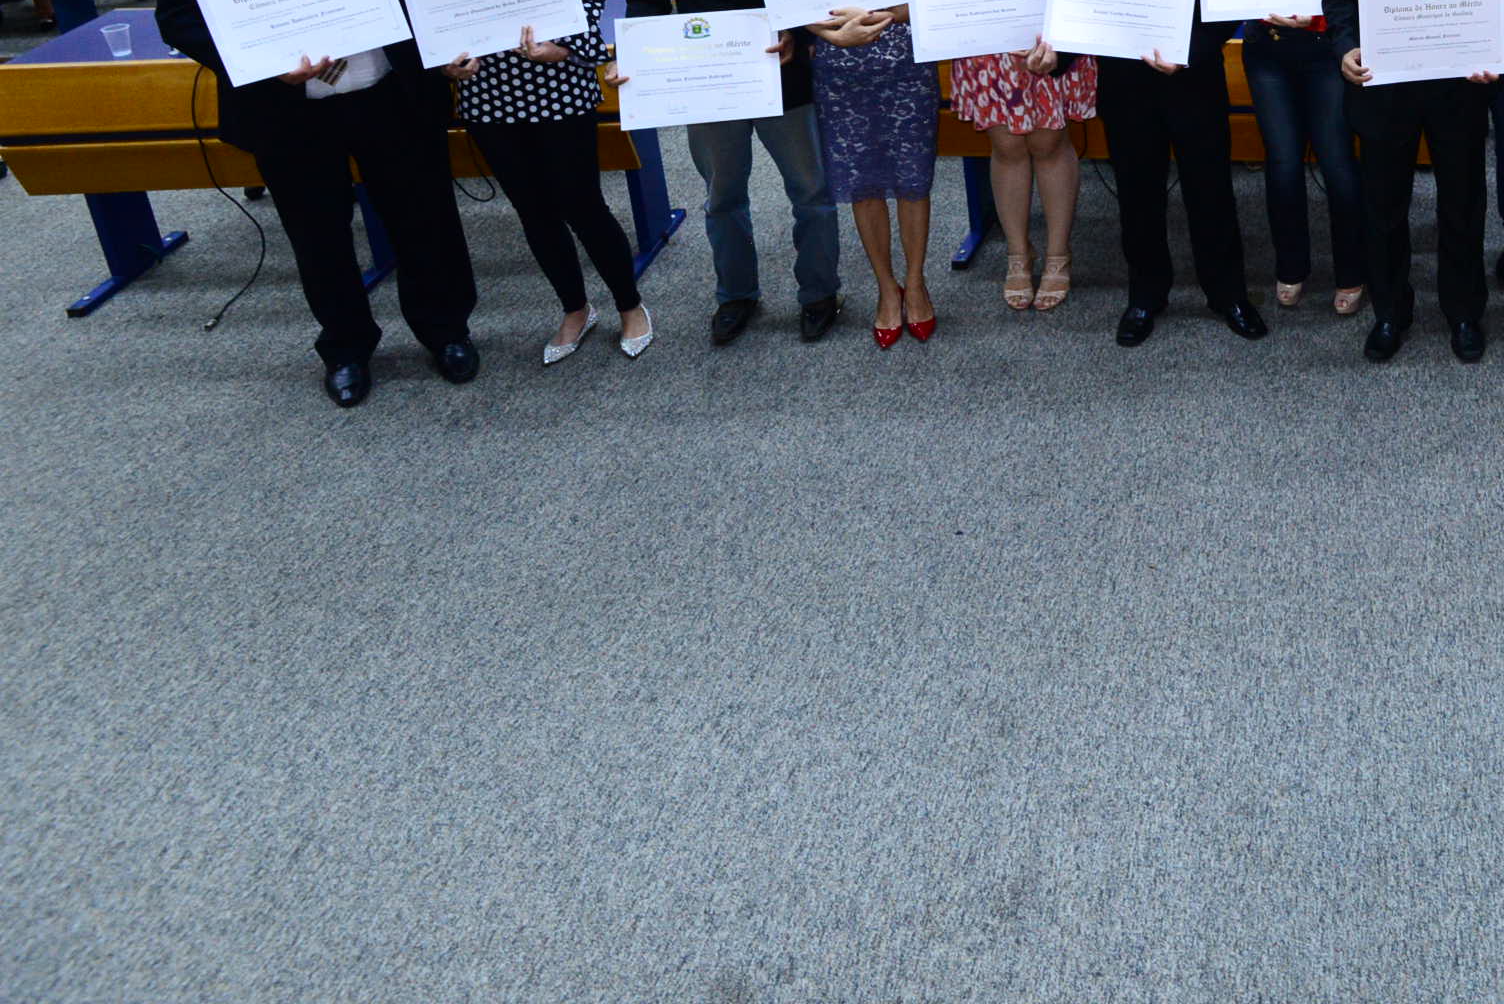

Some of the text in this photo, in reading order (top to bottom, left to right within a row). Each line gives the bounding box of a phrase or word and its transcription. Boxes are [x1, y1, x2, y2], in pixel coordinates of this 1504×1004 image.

[1383, 4, 1412, 14] Diploma
[1425, 2, 1447, 10] Honra
[1460, 0, 1482, 8] Mérito
